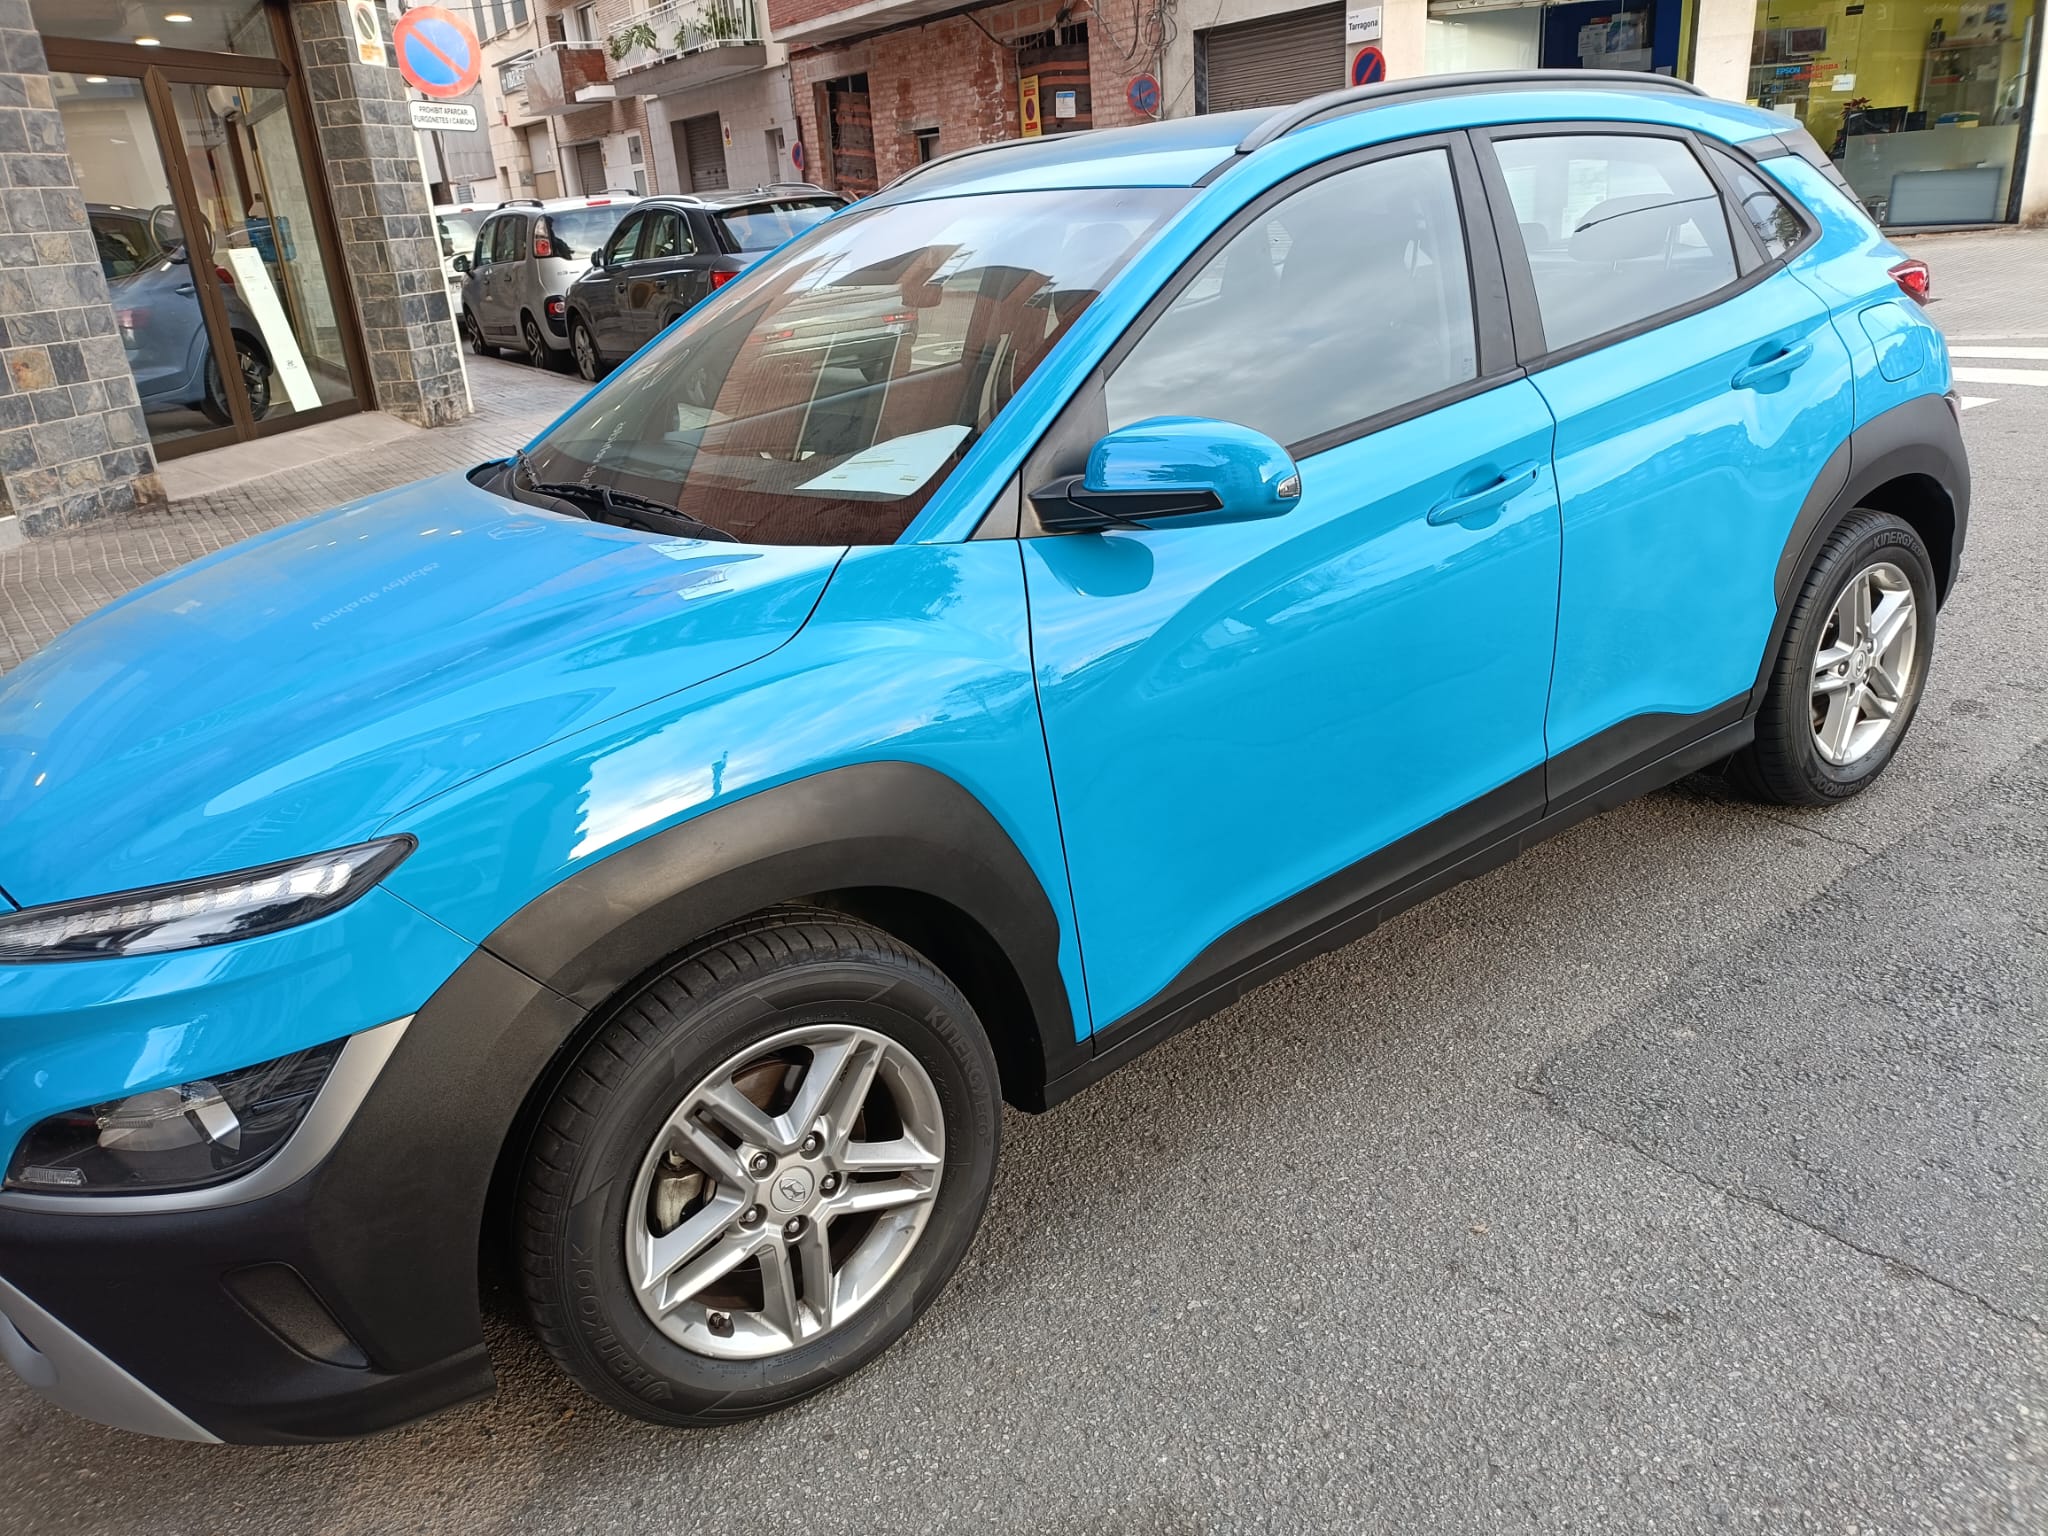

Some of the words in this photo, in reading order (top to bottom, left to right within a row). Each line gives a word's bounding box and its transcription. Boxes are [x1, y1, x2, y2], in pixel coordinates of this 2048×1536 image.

[1349, 20, 1378, 31] Tarragona
[1775, 66, 1802, 75] EPSON
[1805, 63, 1839, 72] TOSHIBA
[419, 106, 443, 115] PROHIBIT
[444, 107, 468, 116] APARCAR
[414, 115, 449, 125] FURGONETES
[453, 118, 475, 126] CAMIONS
